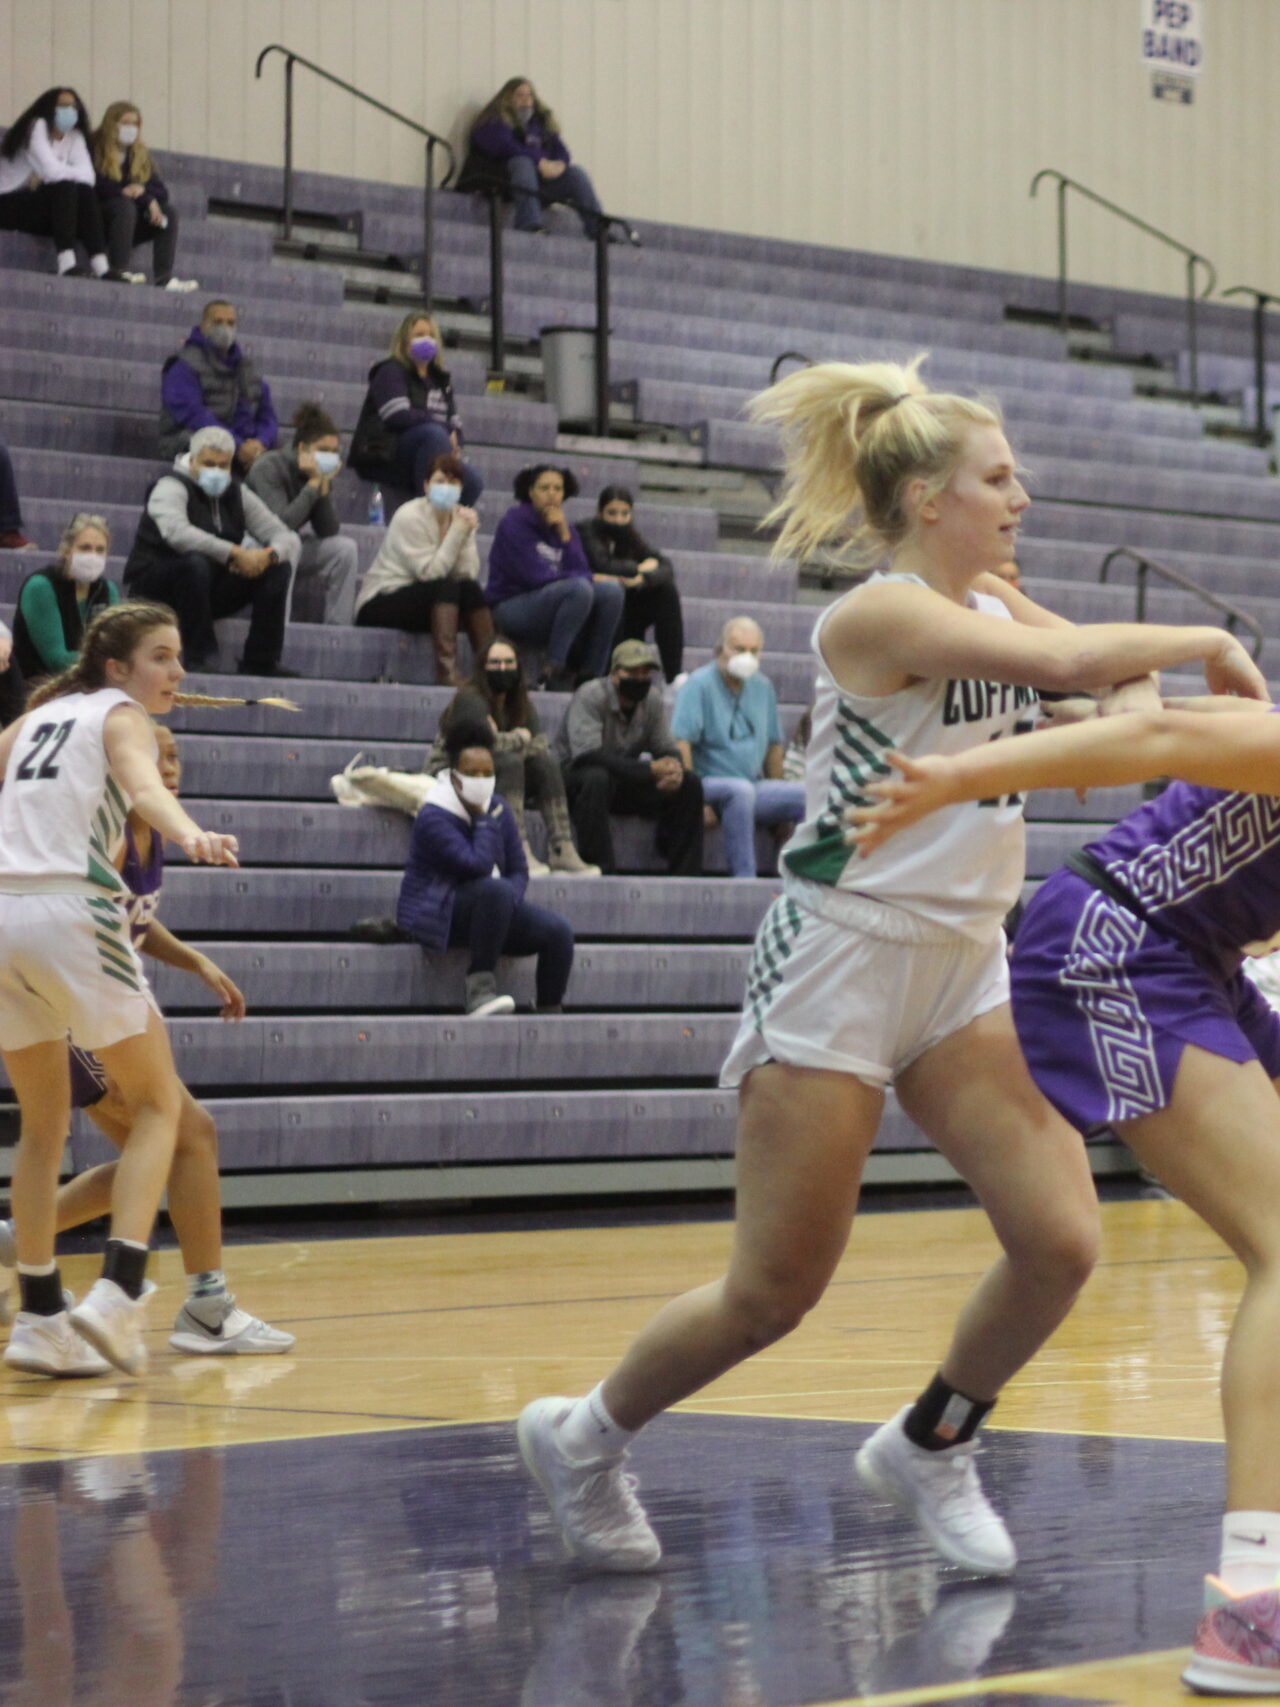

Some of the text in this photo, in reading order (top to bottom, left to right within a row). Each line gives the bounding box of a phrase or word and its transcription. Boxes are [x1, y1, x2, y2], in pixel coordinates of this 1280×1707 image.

[1152, 0, 1192, 29] PEP
[1143, 29, 1202, 67] BAND
[15, 718, 77, 781] 22
